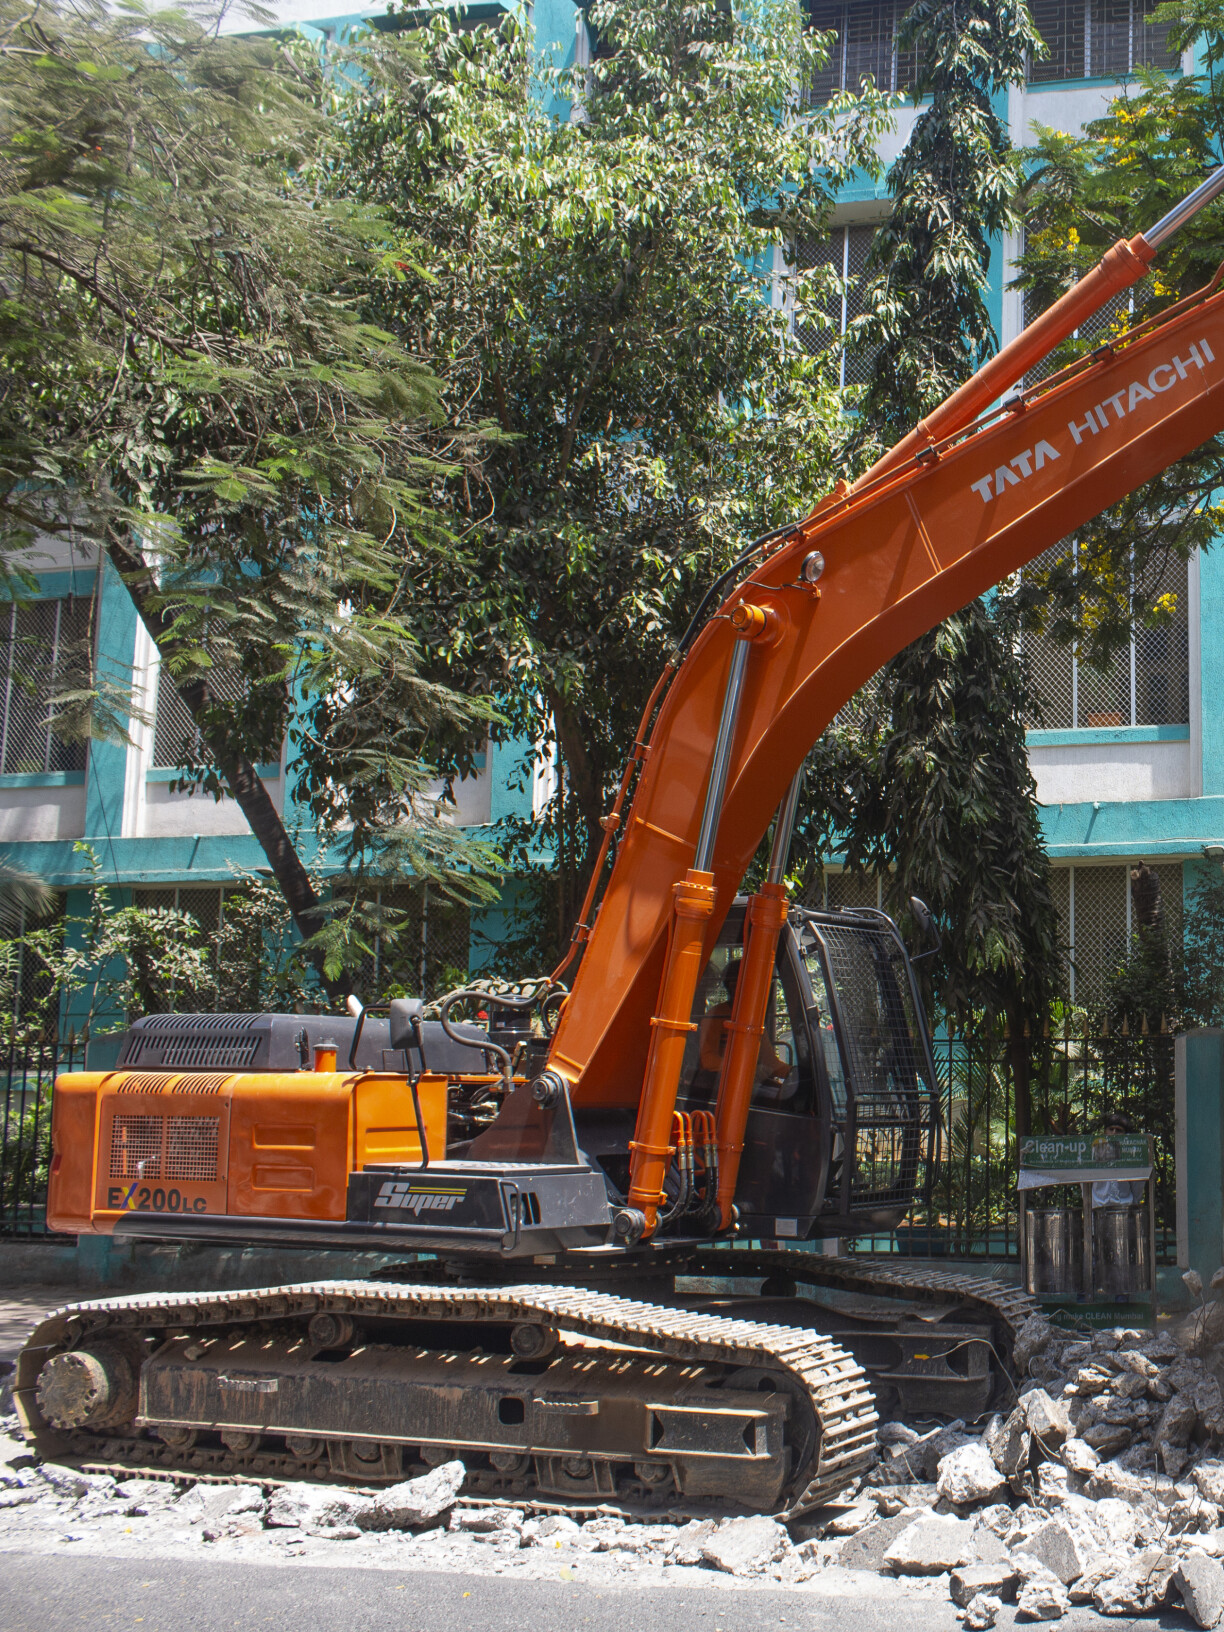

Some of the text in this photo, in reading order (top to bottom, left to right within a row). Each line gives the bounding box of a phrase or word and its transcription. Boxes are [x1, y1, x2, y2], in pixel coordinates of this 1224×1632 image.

[970, 338, 1216, 503] TATA HITACHI
[1025, 1140, 1087, 1157] Clean-up
[107, 1182, 208, 1213] EX200LC
[373, 1182, 466, 1217] Super
[1085, 1311, 1112, 1320] CLEAN
[1114, 1312, 1144, 1320] Mumbai
